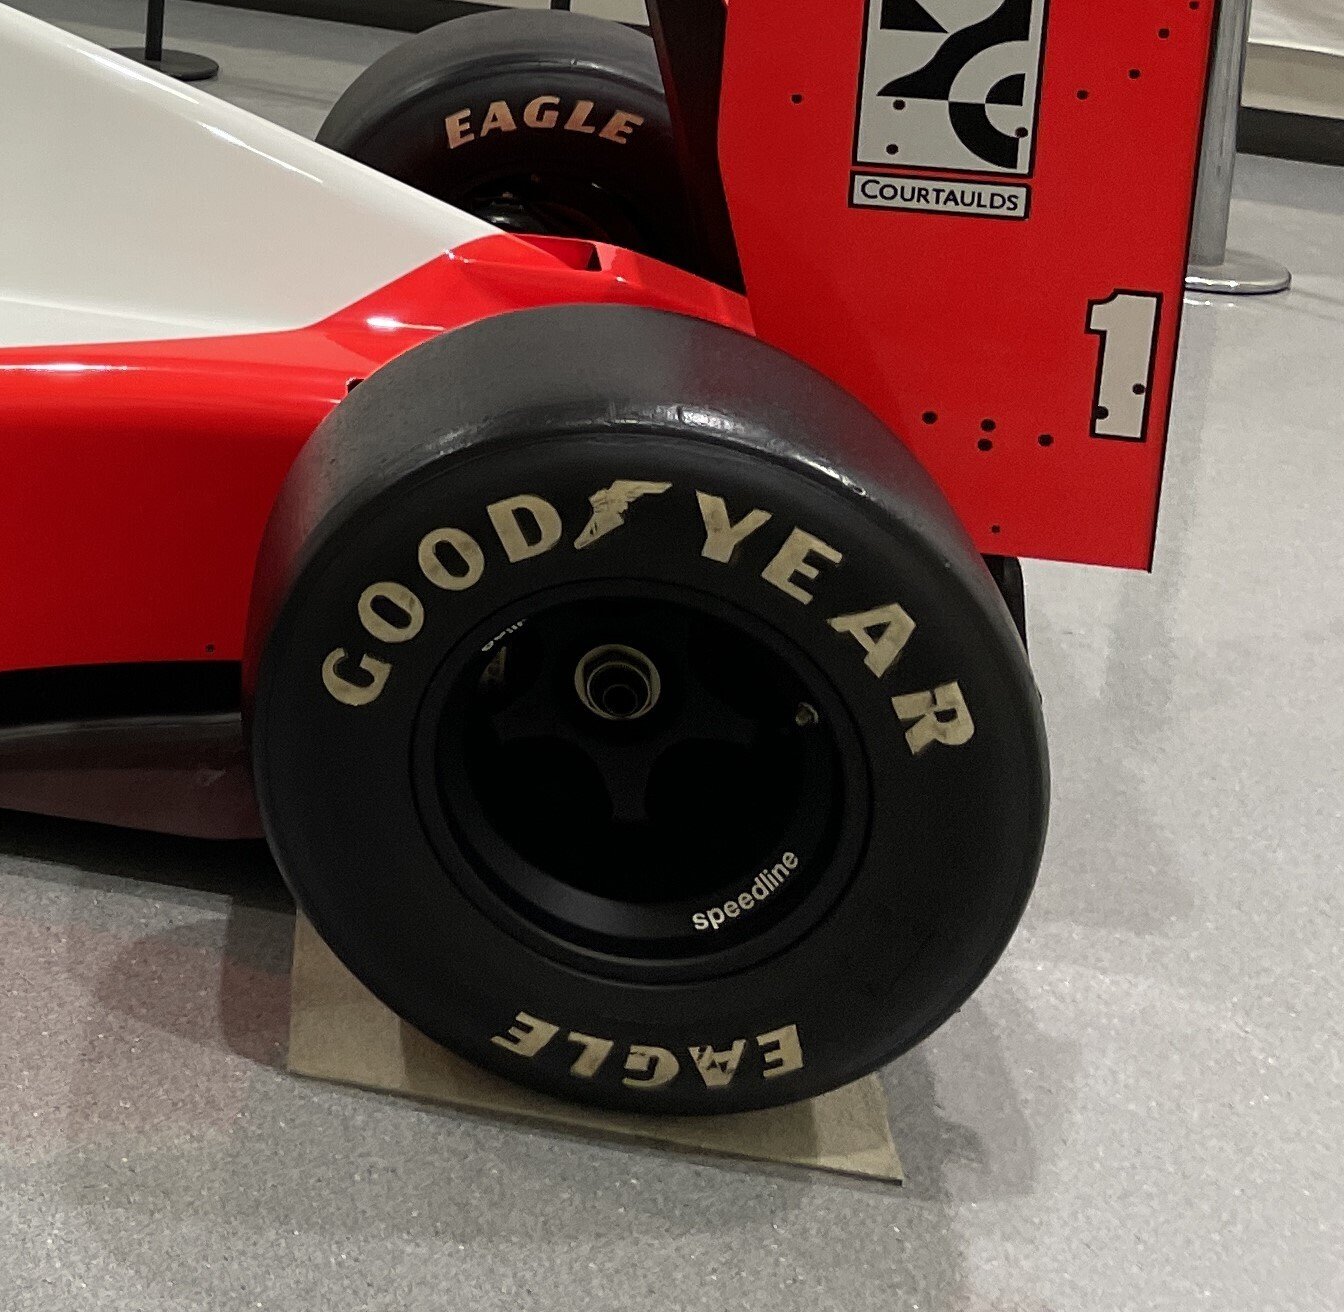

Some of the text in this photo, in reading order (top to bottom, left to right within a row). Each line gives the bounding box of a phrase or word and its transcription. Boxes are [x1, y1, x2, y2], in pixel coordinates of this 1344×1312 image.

[443, 94, 645, 150] EAGLE
[860, 178, 1020, 212] COURTAULDS
[1085, 289, 1162, 441] 1
[691, 848, 800, 933] speedline
[490, 1010, 808, 1090] EAGLE
